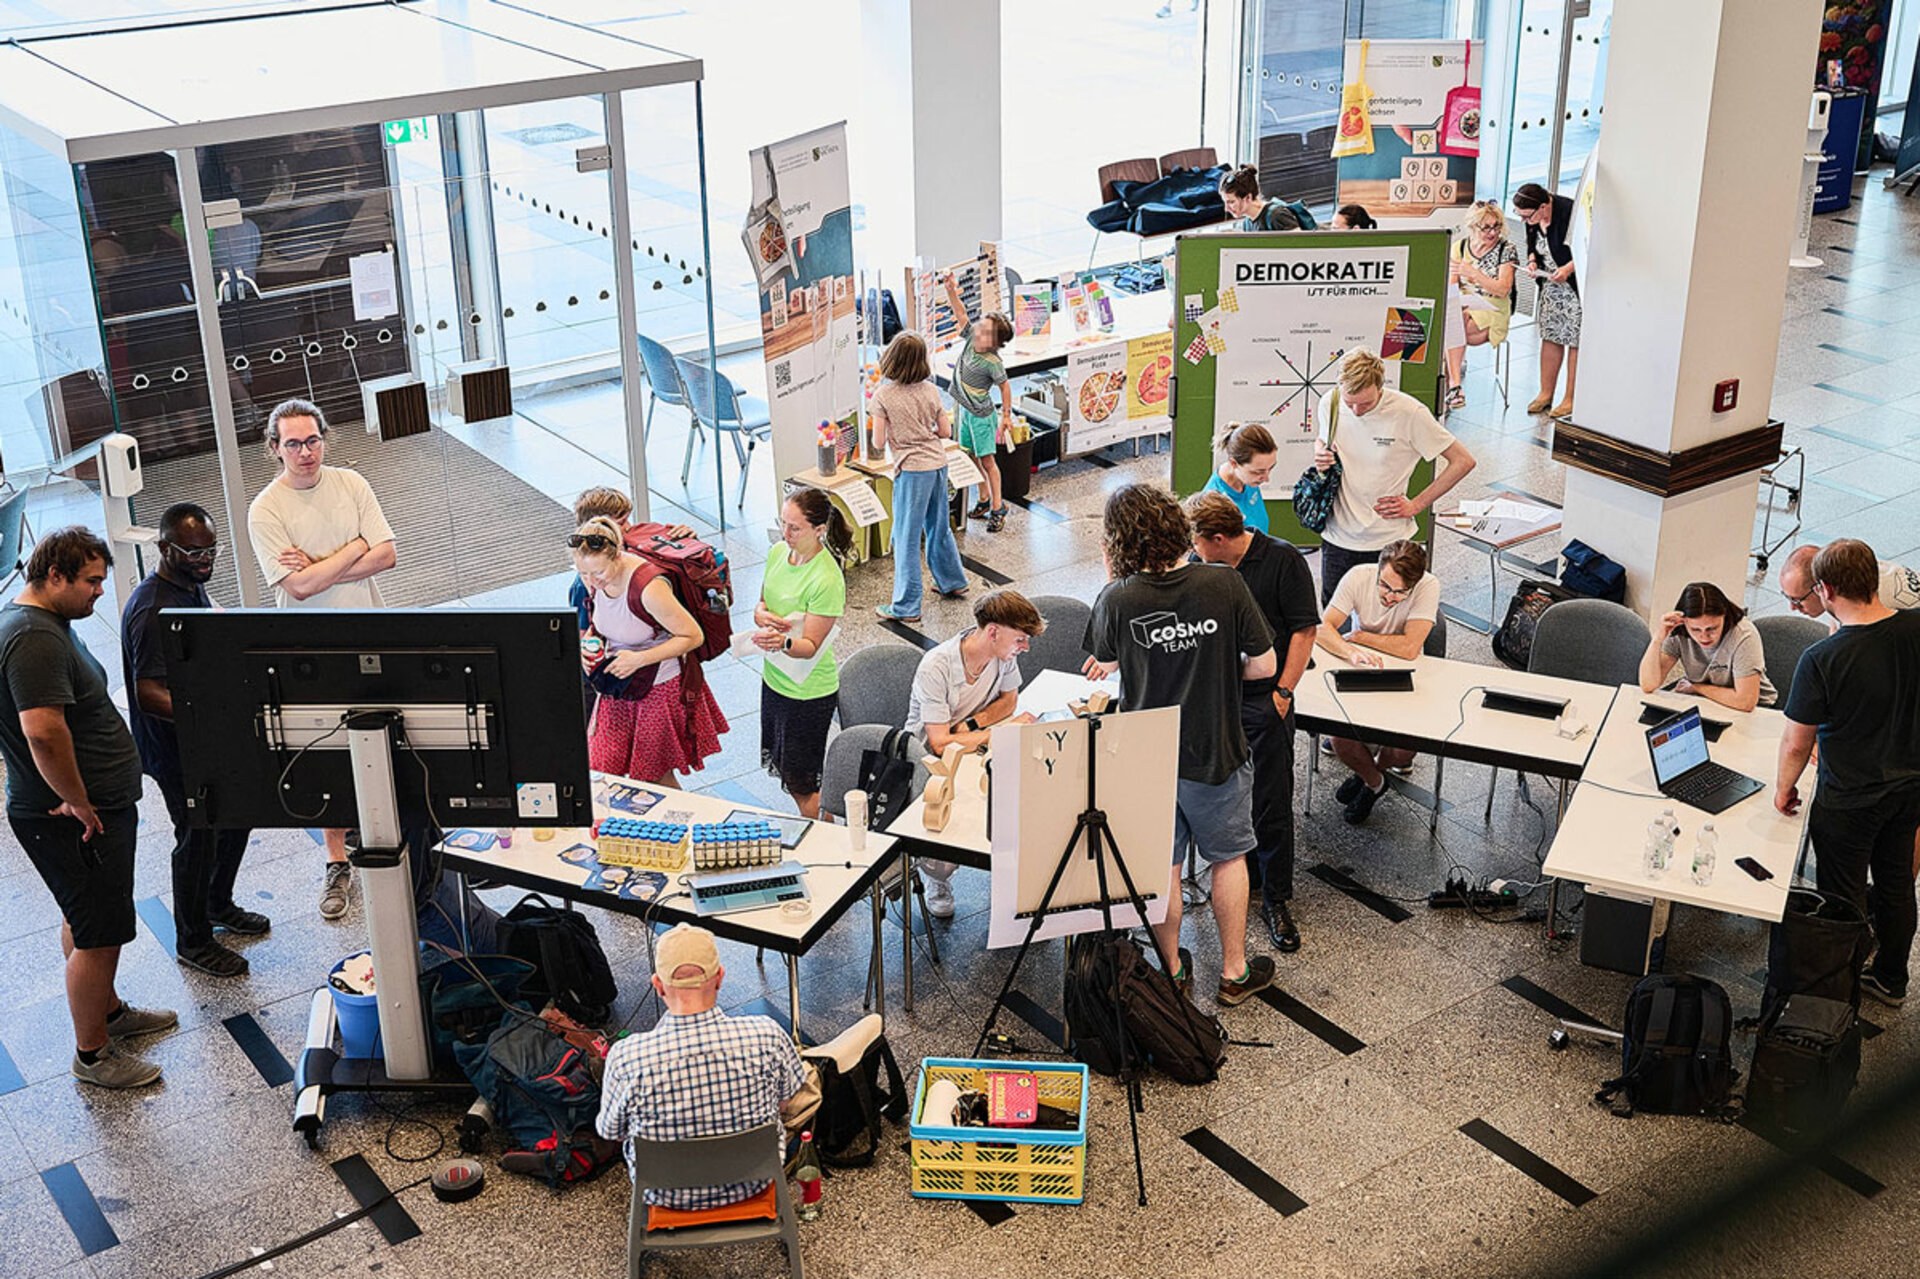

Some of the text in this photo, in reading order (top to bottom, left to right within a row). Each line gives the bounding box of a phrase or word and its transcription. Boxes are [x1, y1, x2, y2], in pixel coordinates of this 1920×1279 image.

[1235, 261, 1395, 282] DEMOKRATIE
[1307, 287, 1324, 297] IST
[1326, 285, 1347, 297] FÜR
[1150, 619, 1218, 643] COSMO
[1161, 638, 1198, 653] TEAM
